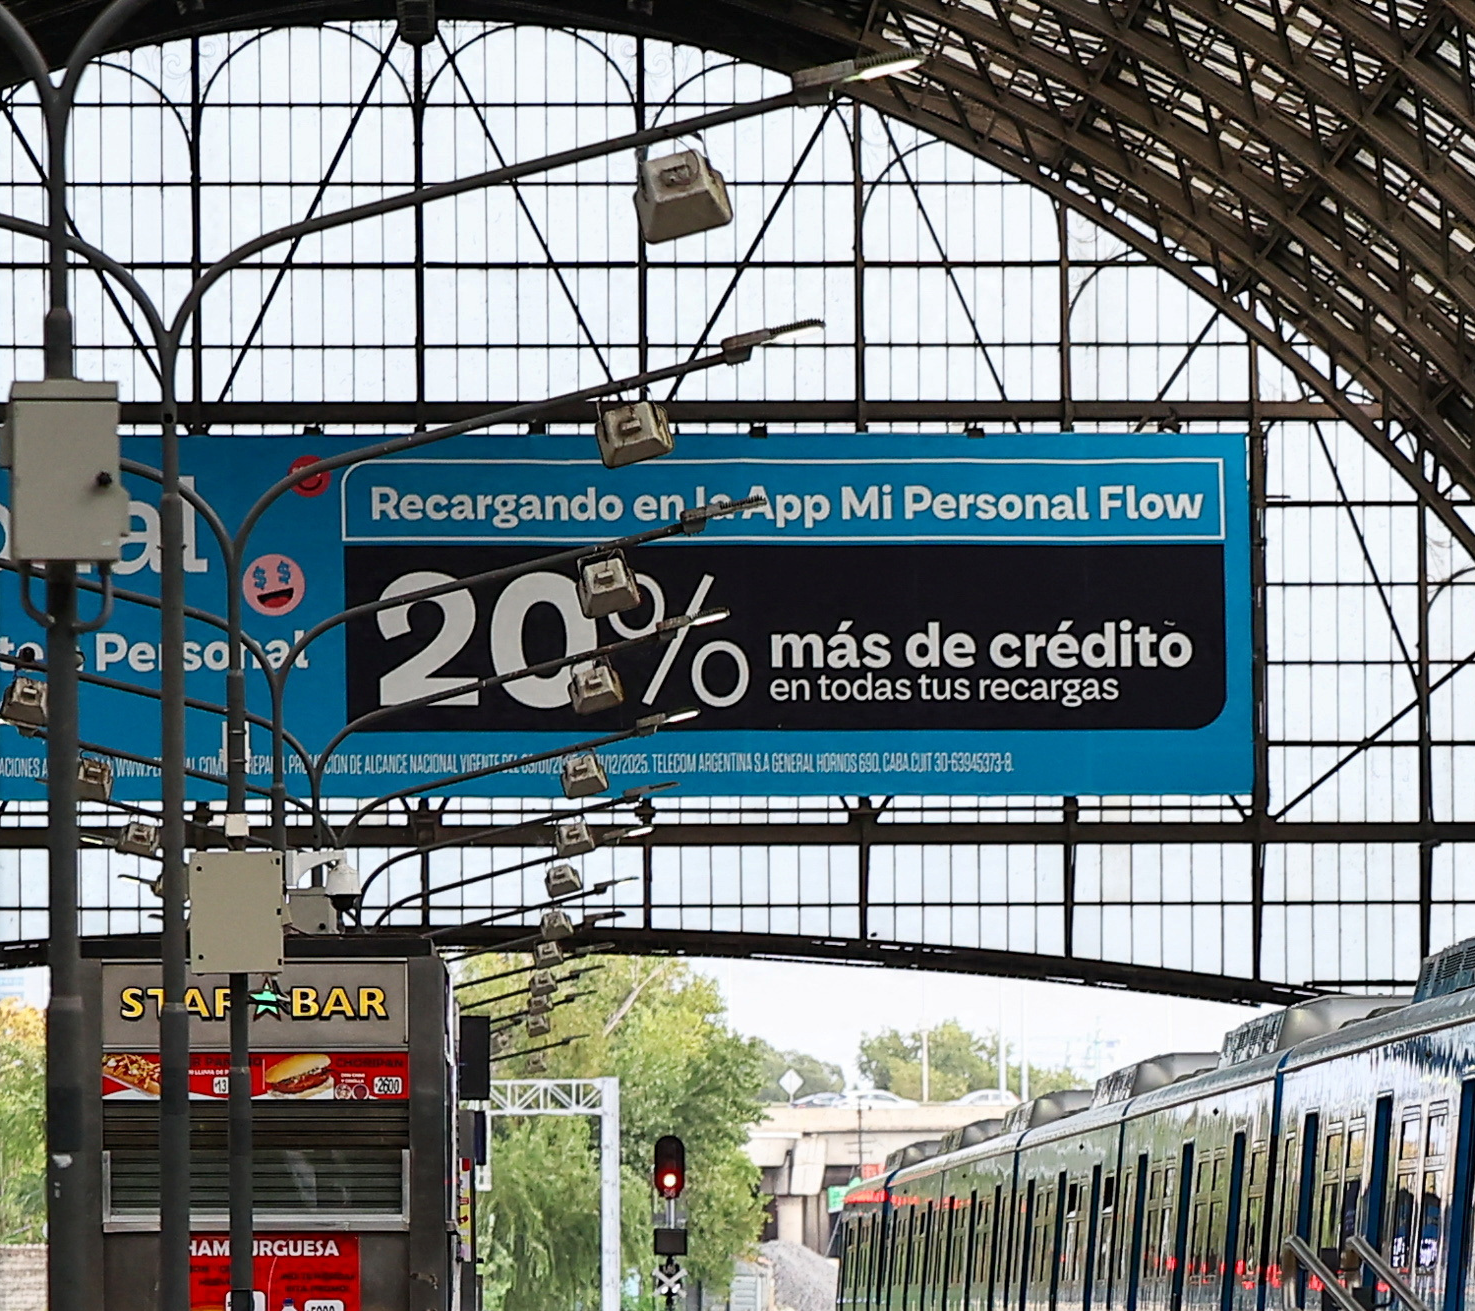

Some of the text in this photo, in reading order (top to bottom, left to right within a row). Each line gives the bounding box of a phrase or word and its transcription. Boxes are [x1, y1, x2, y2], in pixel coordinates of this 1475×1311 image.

[371, 486, 626, 529] Recargando
[633, 499, 683, 521] en
[733, 485, 830, 529] App
[841, 484, 892, 521] Mi
[904, 485, 1090, 522] Personal
[1099, 484, 1204, 521] Flow
[95, 630, 309, 673] Pesonal
[375, 570, 750, 709] 20%
[770, 619, 1194, 669] más de crédito
[769, 672, 1120, 708] en todas tus recargas
[349, 754, 363, 774] DE
[364, 754, 407, 774] ALCANCE
[409, 754, 459, 774] NACIONAL
[596, 753, 651, 774] 1/12/2025.
[652, 753, 696, 774] TELECOM
[698, 752, 753, 774] ARGENTINA
[771, 752, 815, 774] GENERAL
[816, 752, 858, 774] HORNOS
[291, 986, 390, 1019] BAR
